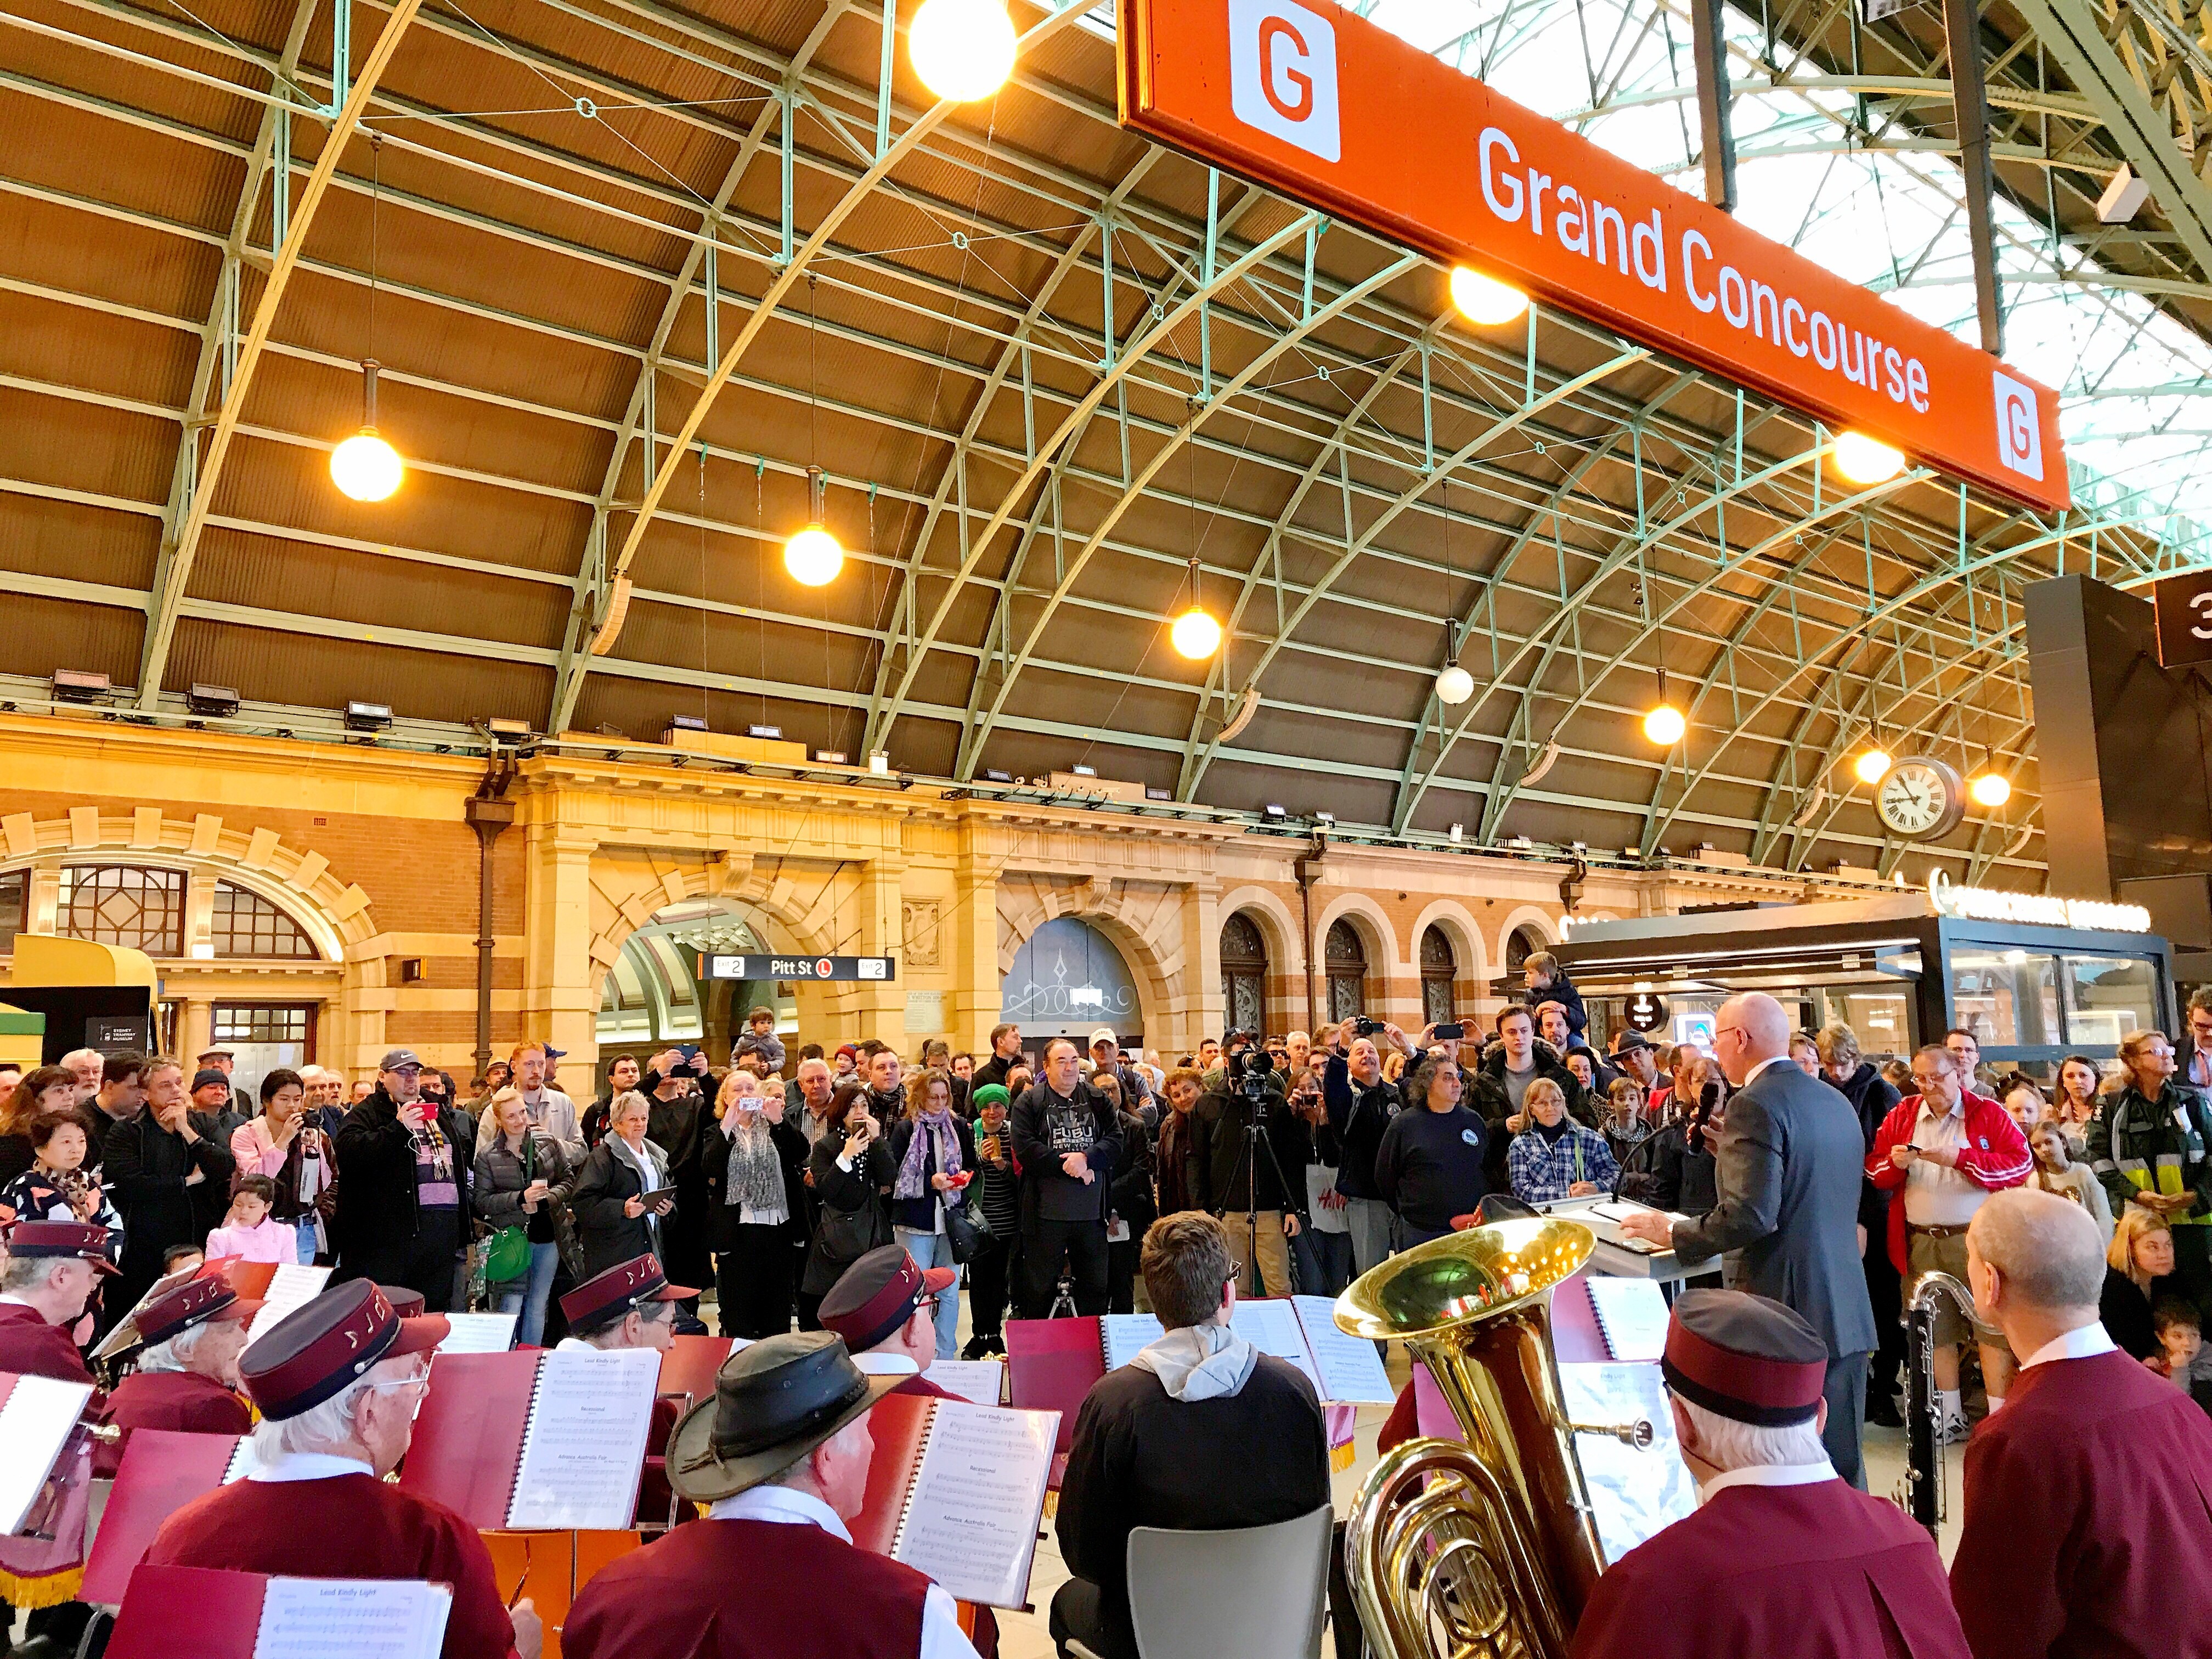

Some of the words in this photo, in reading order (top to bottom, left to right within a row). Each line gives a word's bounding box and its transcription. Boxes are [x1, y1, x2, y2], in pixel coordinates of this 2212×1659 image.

[1259, 15, 1313, 122] G
[1478, 127, 1667, 292] Grand
[1683, 228, 1930, 414] Concourse
[2006, 394, 2030, 460] G
[732, 960, 740, 973] 2
[771, 960, 795, 975] Pitt
[798, 960, 812, 975] St
[874, 962, 882, 975] 2
[1053, 1126, 1093, 1139] FUBU
[969, 1465, 996, 1474] Recessional
[337, 1588, 357, 1597] Kindly
[359, 1589, 377, 1598] Light
